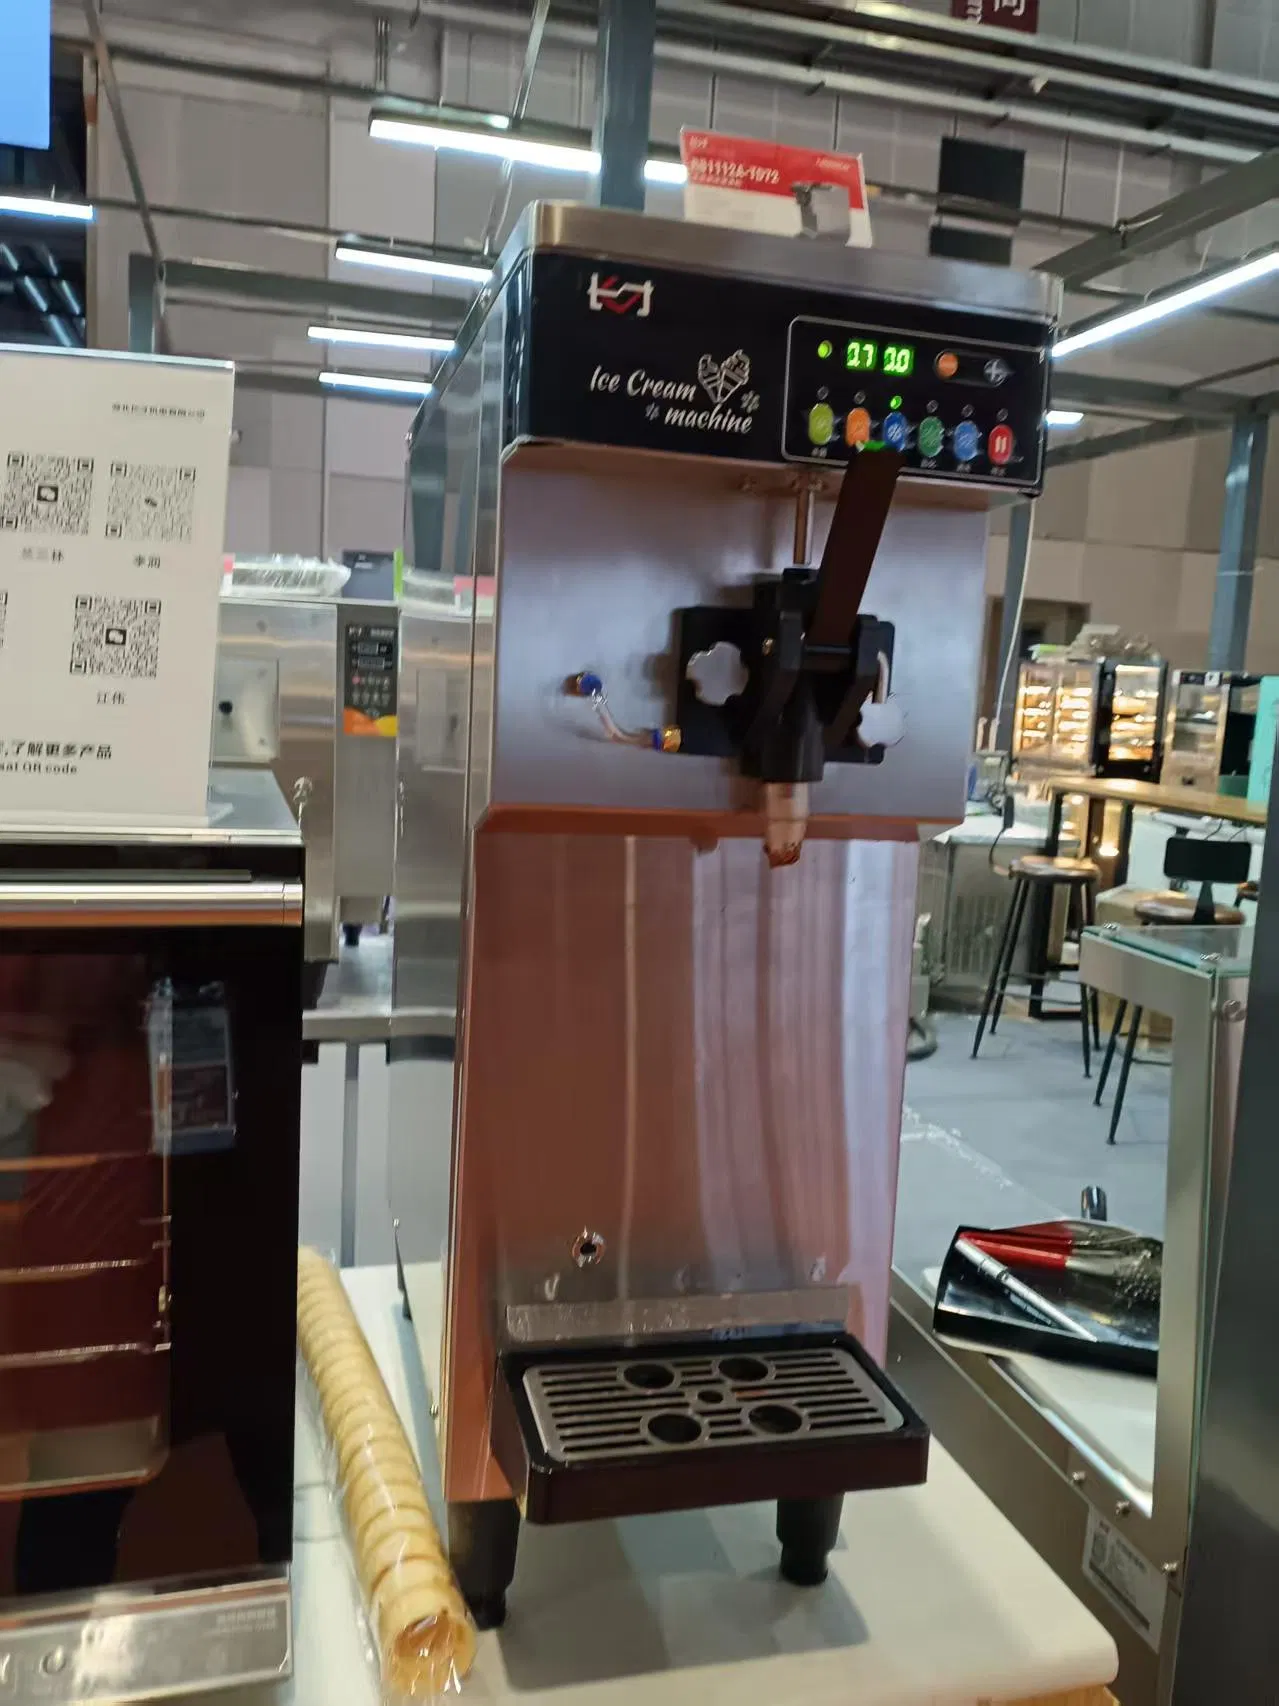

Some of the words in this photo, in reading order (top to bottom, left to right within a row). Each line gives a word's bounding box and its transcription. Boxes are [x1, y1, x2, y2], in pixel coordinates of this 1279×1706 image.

[589, 364, 621, 394] Ice
[626, 368, 698, 402] Cream
[663, 403, 753, 434] machine
[45, 763, 78, 775] code
